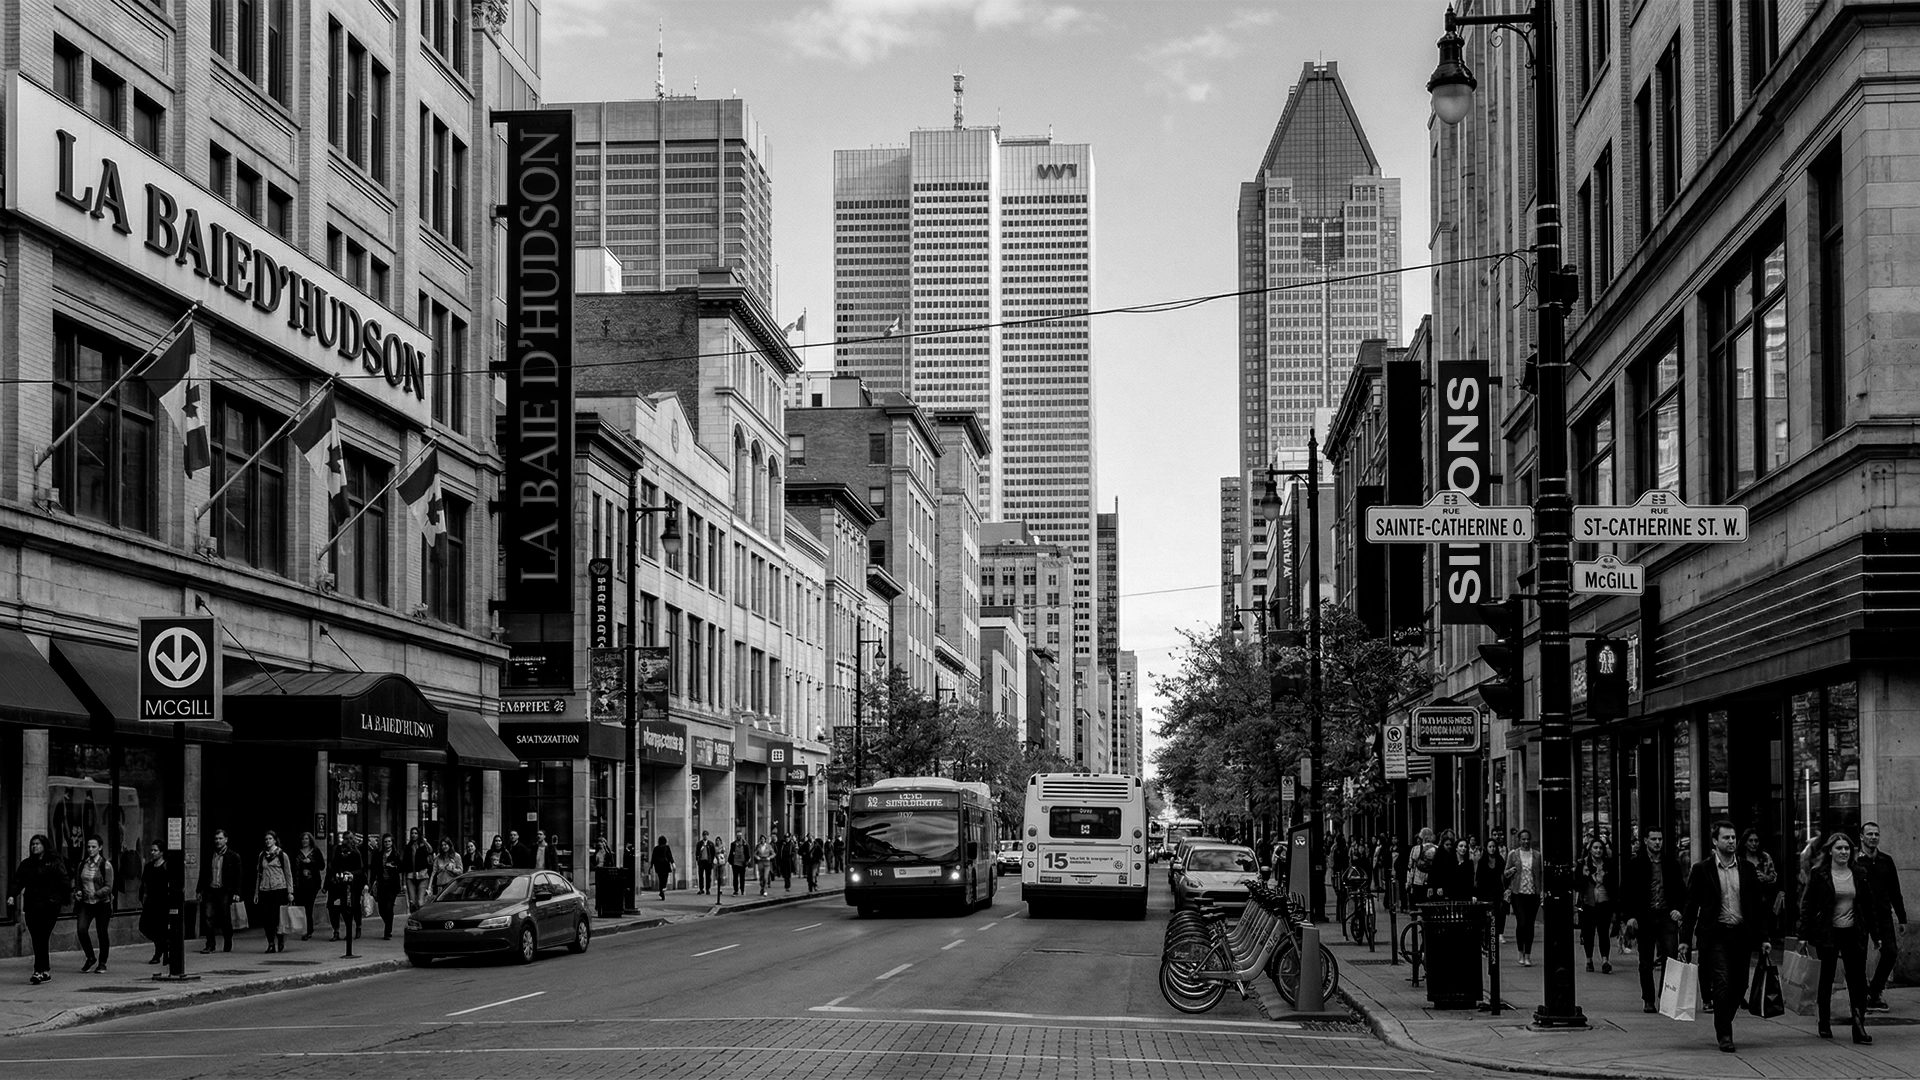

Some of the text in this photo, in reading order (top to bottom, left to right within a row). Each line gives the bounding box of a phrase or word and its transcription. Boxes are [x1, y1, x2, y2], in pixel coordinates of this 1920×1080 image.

[55, 128, 133, 235] LA
[518, 128, 561, 583] LA BAIE D'HUDSON
[1446, 377, 1482, 604] SIONS
[1442, 507, 1461, 515] RUE
[1650, 507, 1669, 515] RUE
[1375, 517, 1527, 537] SAINTE-CATHERINE O.
[1583, 517, 1741, 537] ST-CATHERINE ST. W.
[1585, 571, 1638, 590] McGILL
[145, 699, 212, 716] MCGILL
[1044, 852, 1069, 870] 15
